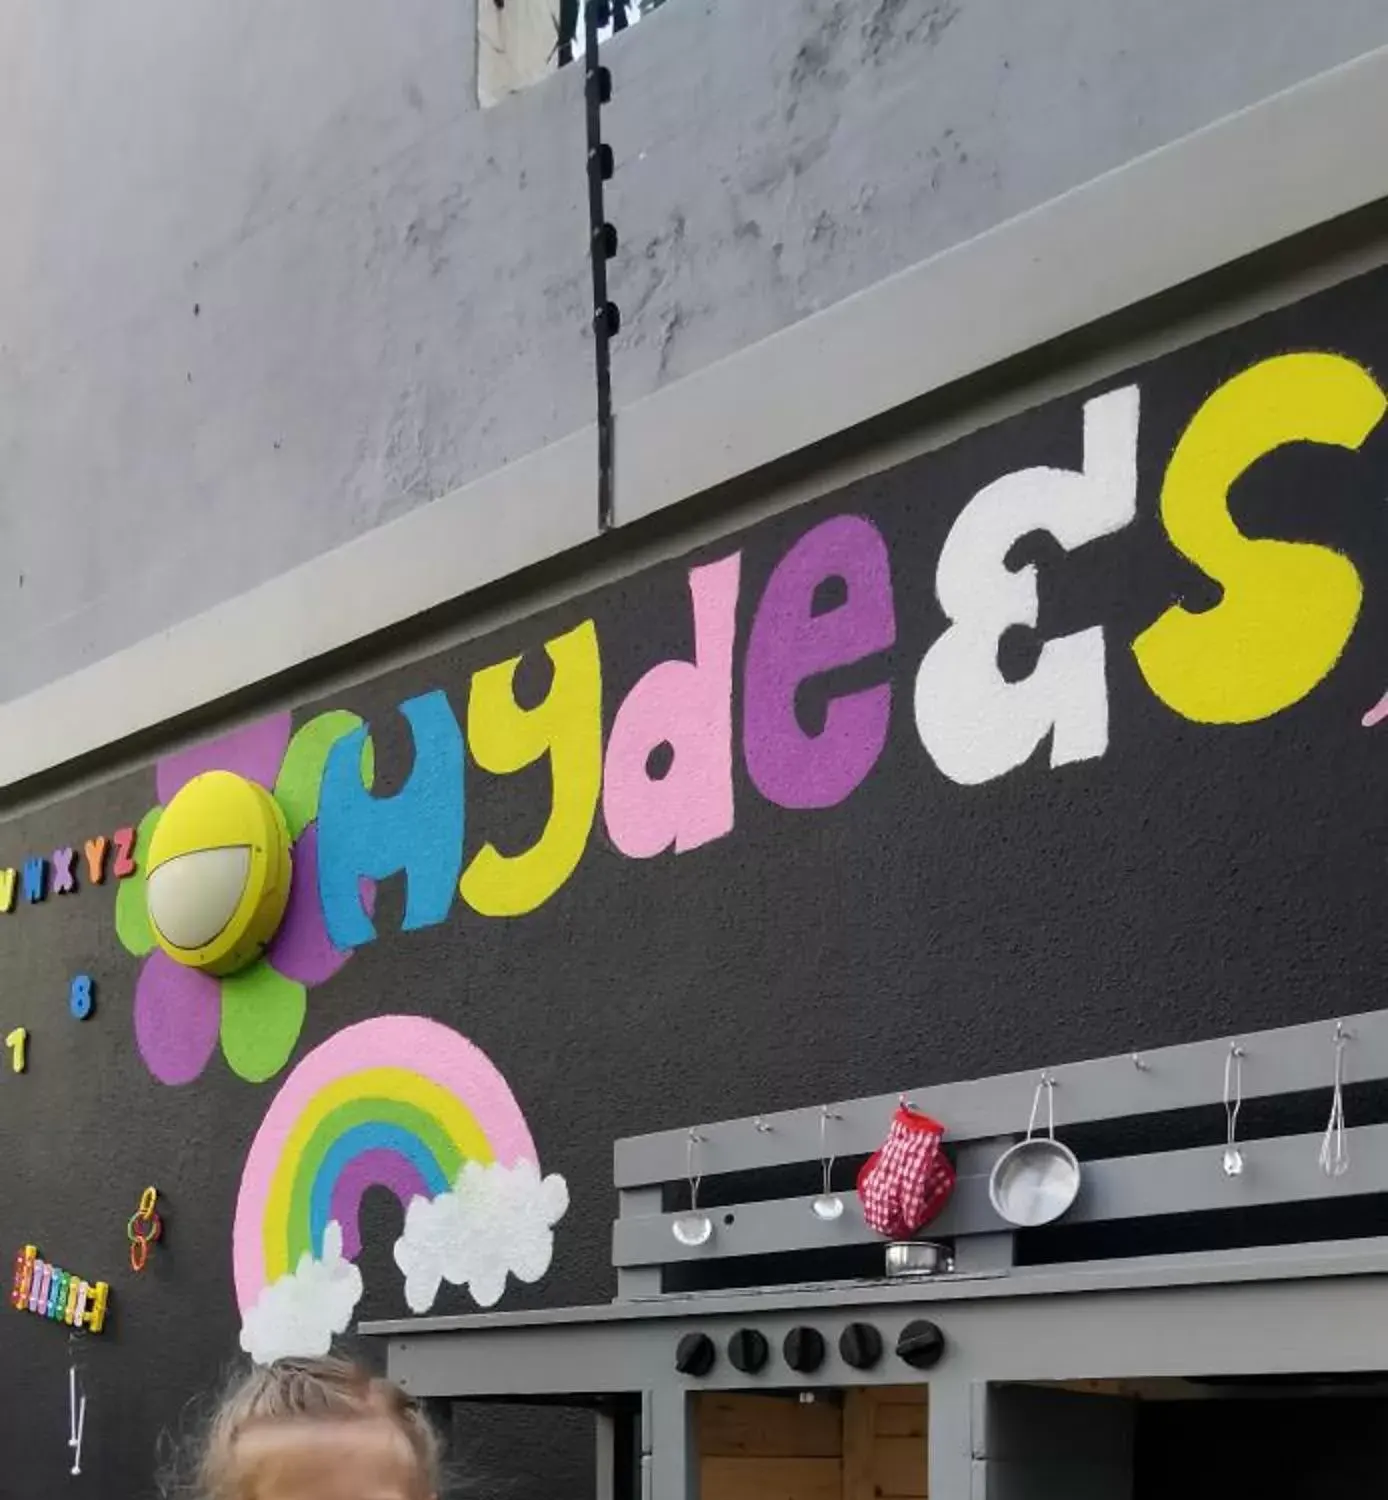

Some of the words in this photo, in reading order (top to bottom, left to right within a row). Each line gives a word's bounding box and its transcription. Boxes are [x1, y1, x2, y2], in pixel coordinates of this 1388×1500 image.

[316, 513, 896, 953] Hyde
[913, 383, 1140, 786] &
[1131, 351, 1388, 727] S
[52, 846, 74, 894] X
[84, 836, 106, 884] Y
[113, 827, 135, 878] Z
[70, 975, 93, 1019] 8
